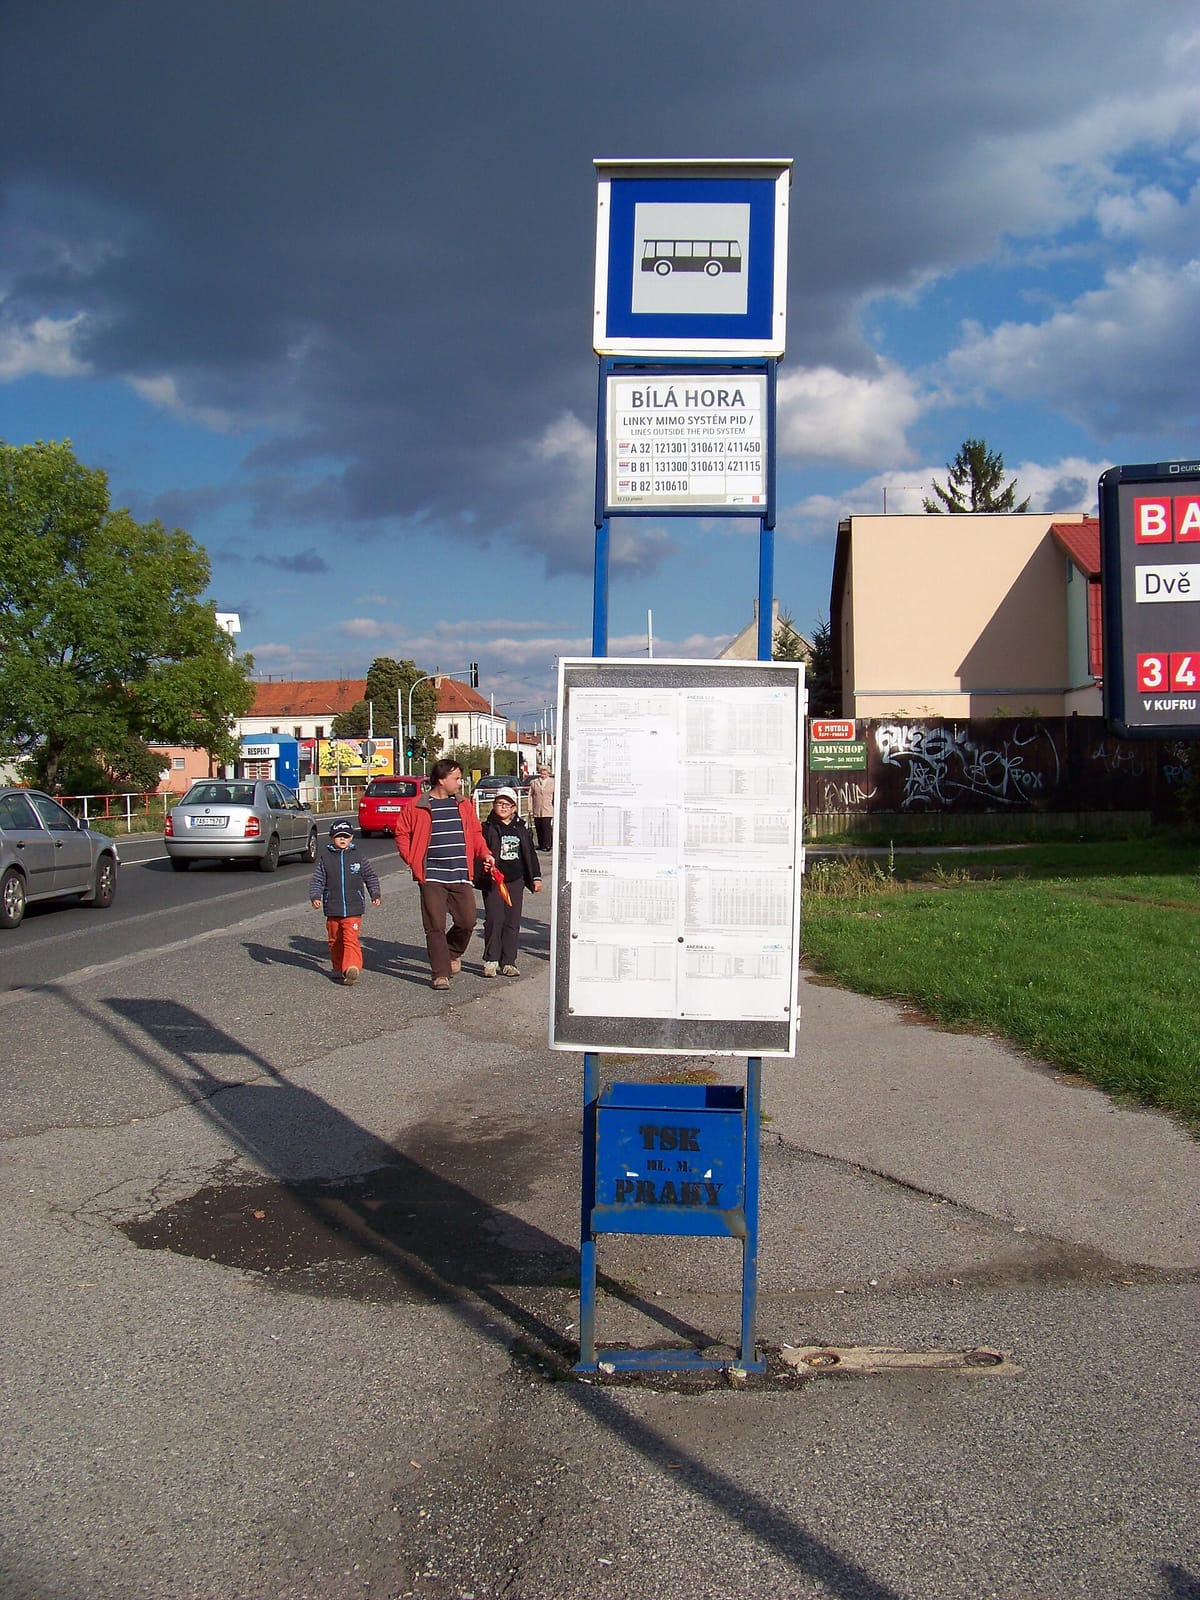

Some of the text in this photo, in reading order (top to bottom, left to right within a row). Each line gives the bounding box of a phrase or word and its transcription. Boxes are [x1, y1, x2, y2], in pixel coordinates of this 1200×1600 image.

[632, 386, 745, 408] BÍLÁ HORA
[623, 416, 653, 426] LINKY
[656, 416, 685, 425] MIMO
[688, 414, 727, 425] SYSTÉM
[730, 416, 746, 424] PID
[631, 444, 637, 453] A
[640, 444, 650, 453] 32
[655, 443, 687, 453] 121301
[691, 442, 724, 452] 310612
[728, 442, 760, 452] 411450
[631, 463, 637, 472] B
[640, 463, 650, 472] 81
[655, 462, 687, 471] 131300
[691, 461, 724, 471] 310613
[728, 461, 760, 471] 421115
[1180, 464, 1200, 472] euro
[631, 481, 637, 491] B
[640, 481, 650, 491] 82
[655, 481, 687, 490] 310610
[1145, 572, 1191, 594] Dvě
[1143, 657, 1196, 687] 34
[1143, 700, 1196, 710] V KUFRU
[247, 747, 270, 756] RESPEKT
[639, 1125, 701, 1151] TSK
[615, 1179, 723, 1205] PRAHY
